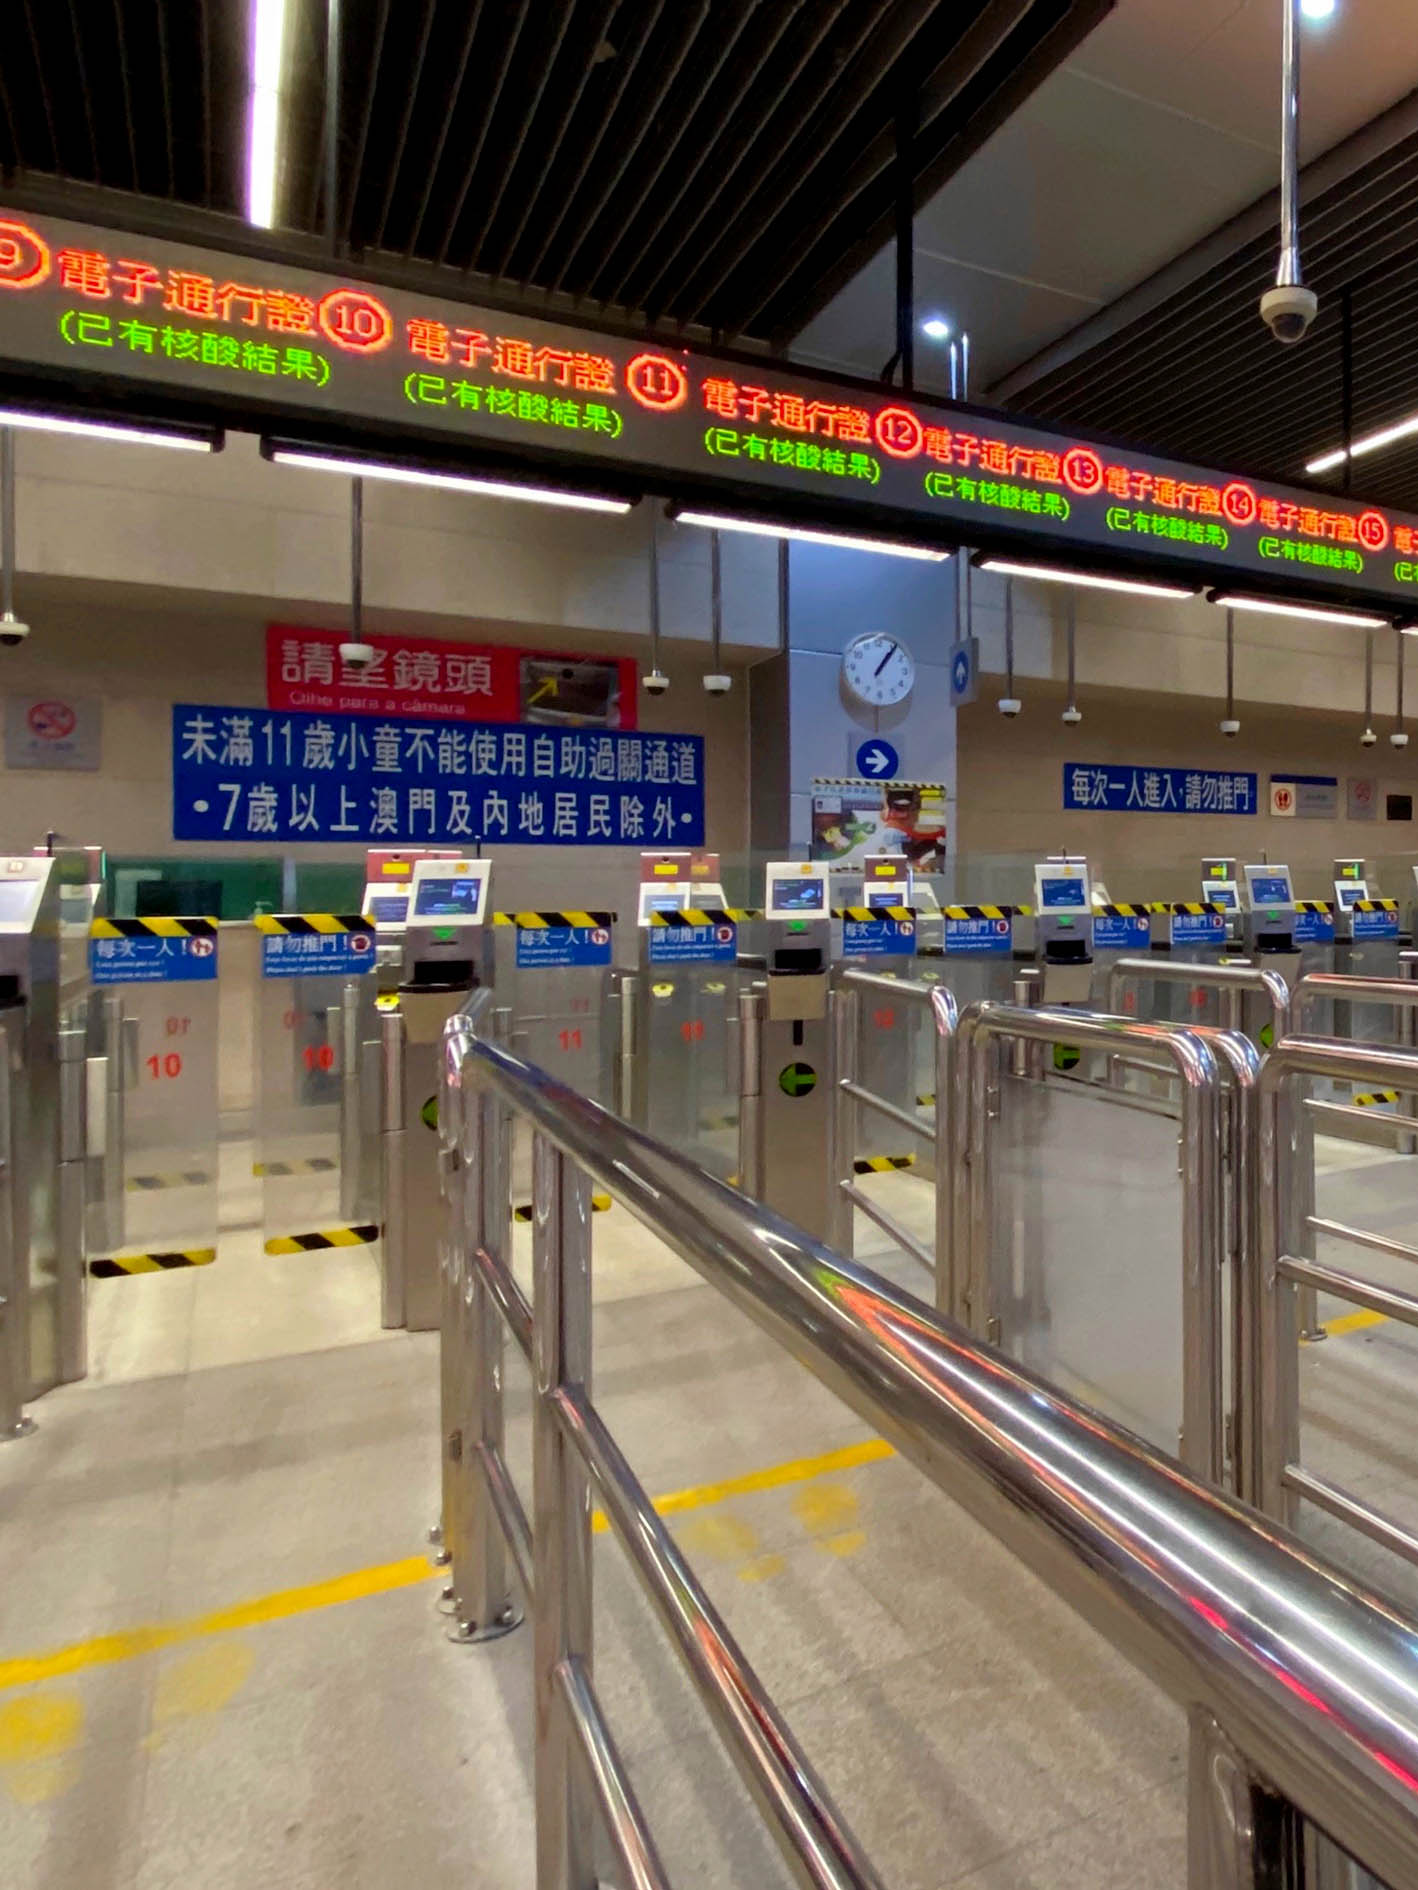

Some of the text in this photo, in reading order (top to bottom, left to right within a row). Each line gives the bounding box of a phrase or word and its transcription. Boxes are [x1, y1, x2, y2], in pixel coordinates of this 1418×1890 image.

[57, 248, 319, 337] 電子通行證
[406, 318, 617, 395] 電子通行證
[702, 377, 873, 444] 電子通行證
[924, 427, 1063, 485] 電子通行證
[1104, 466, 1223, 516] 電子通行證
[339, 695, 379, 711] para
[182, 714, 697, 785] 未滿11歲小童不能使用自助過關通道
[145, 1053, 183, 1078] 10
